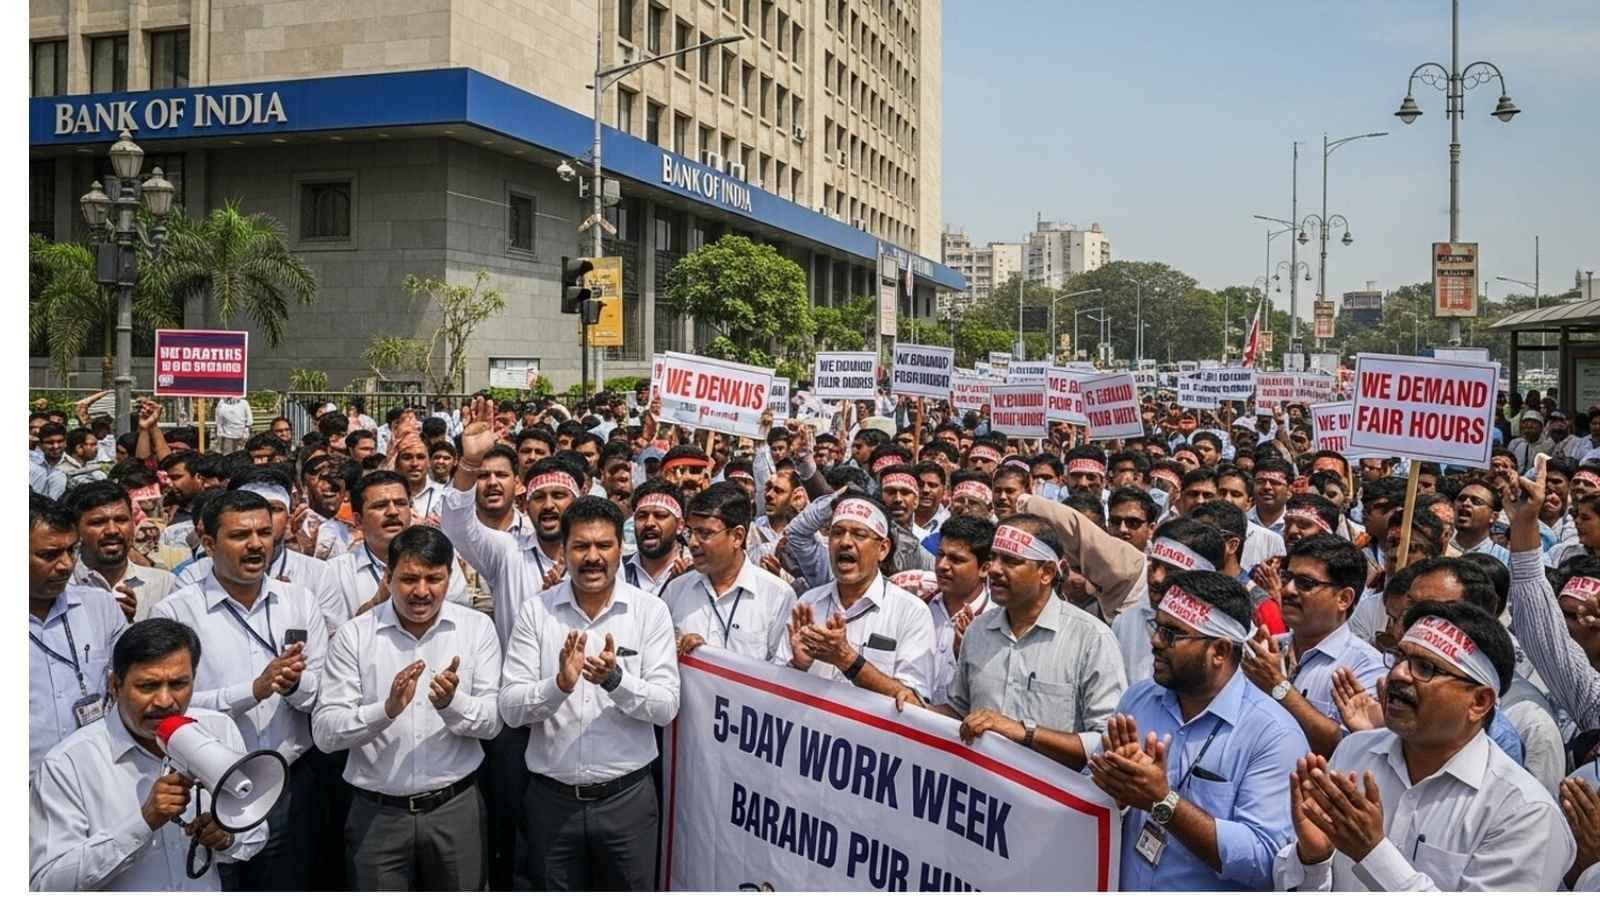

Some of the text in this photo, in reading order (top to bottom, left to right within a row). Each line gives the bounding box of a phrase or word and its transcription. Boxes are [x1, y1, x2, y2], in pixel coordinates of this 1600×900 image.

[54, 91, 288, 135] BANK OF INDIA
[662, 153, 753, 213] BANK OF INDIA
[665, 367, 693, 397] WE
[1362, 371, 1392, 400] WE
[1397, 374, 1488, 408] DEMAND
[1356, 405, 1485, 445] FAIR HOURS
[712, 694, 1012, 861] 5-DAY WORK WEEK
[730, 781, 910, 892] BARAND PUR
